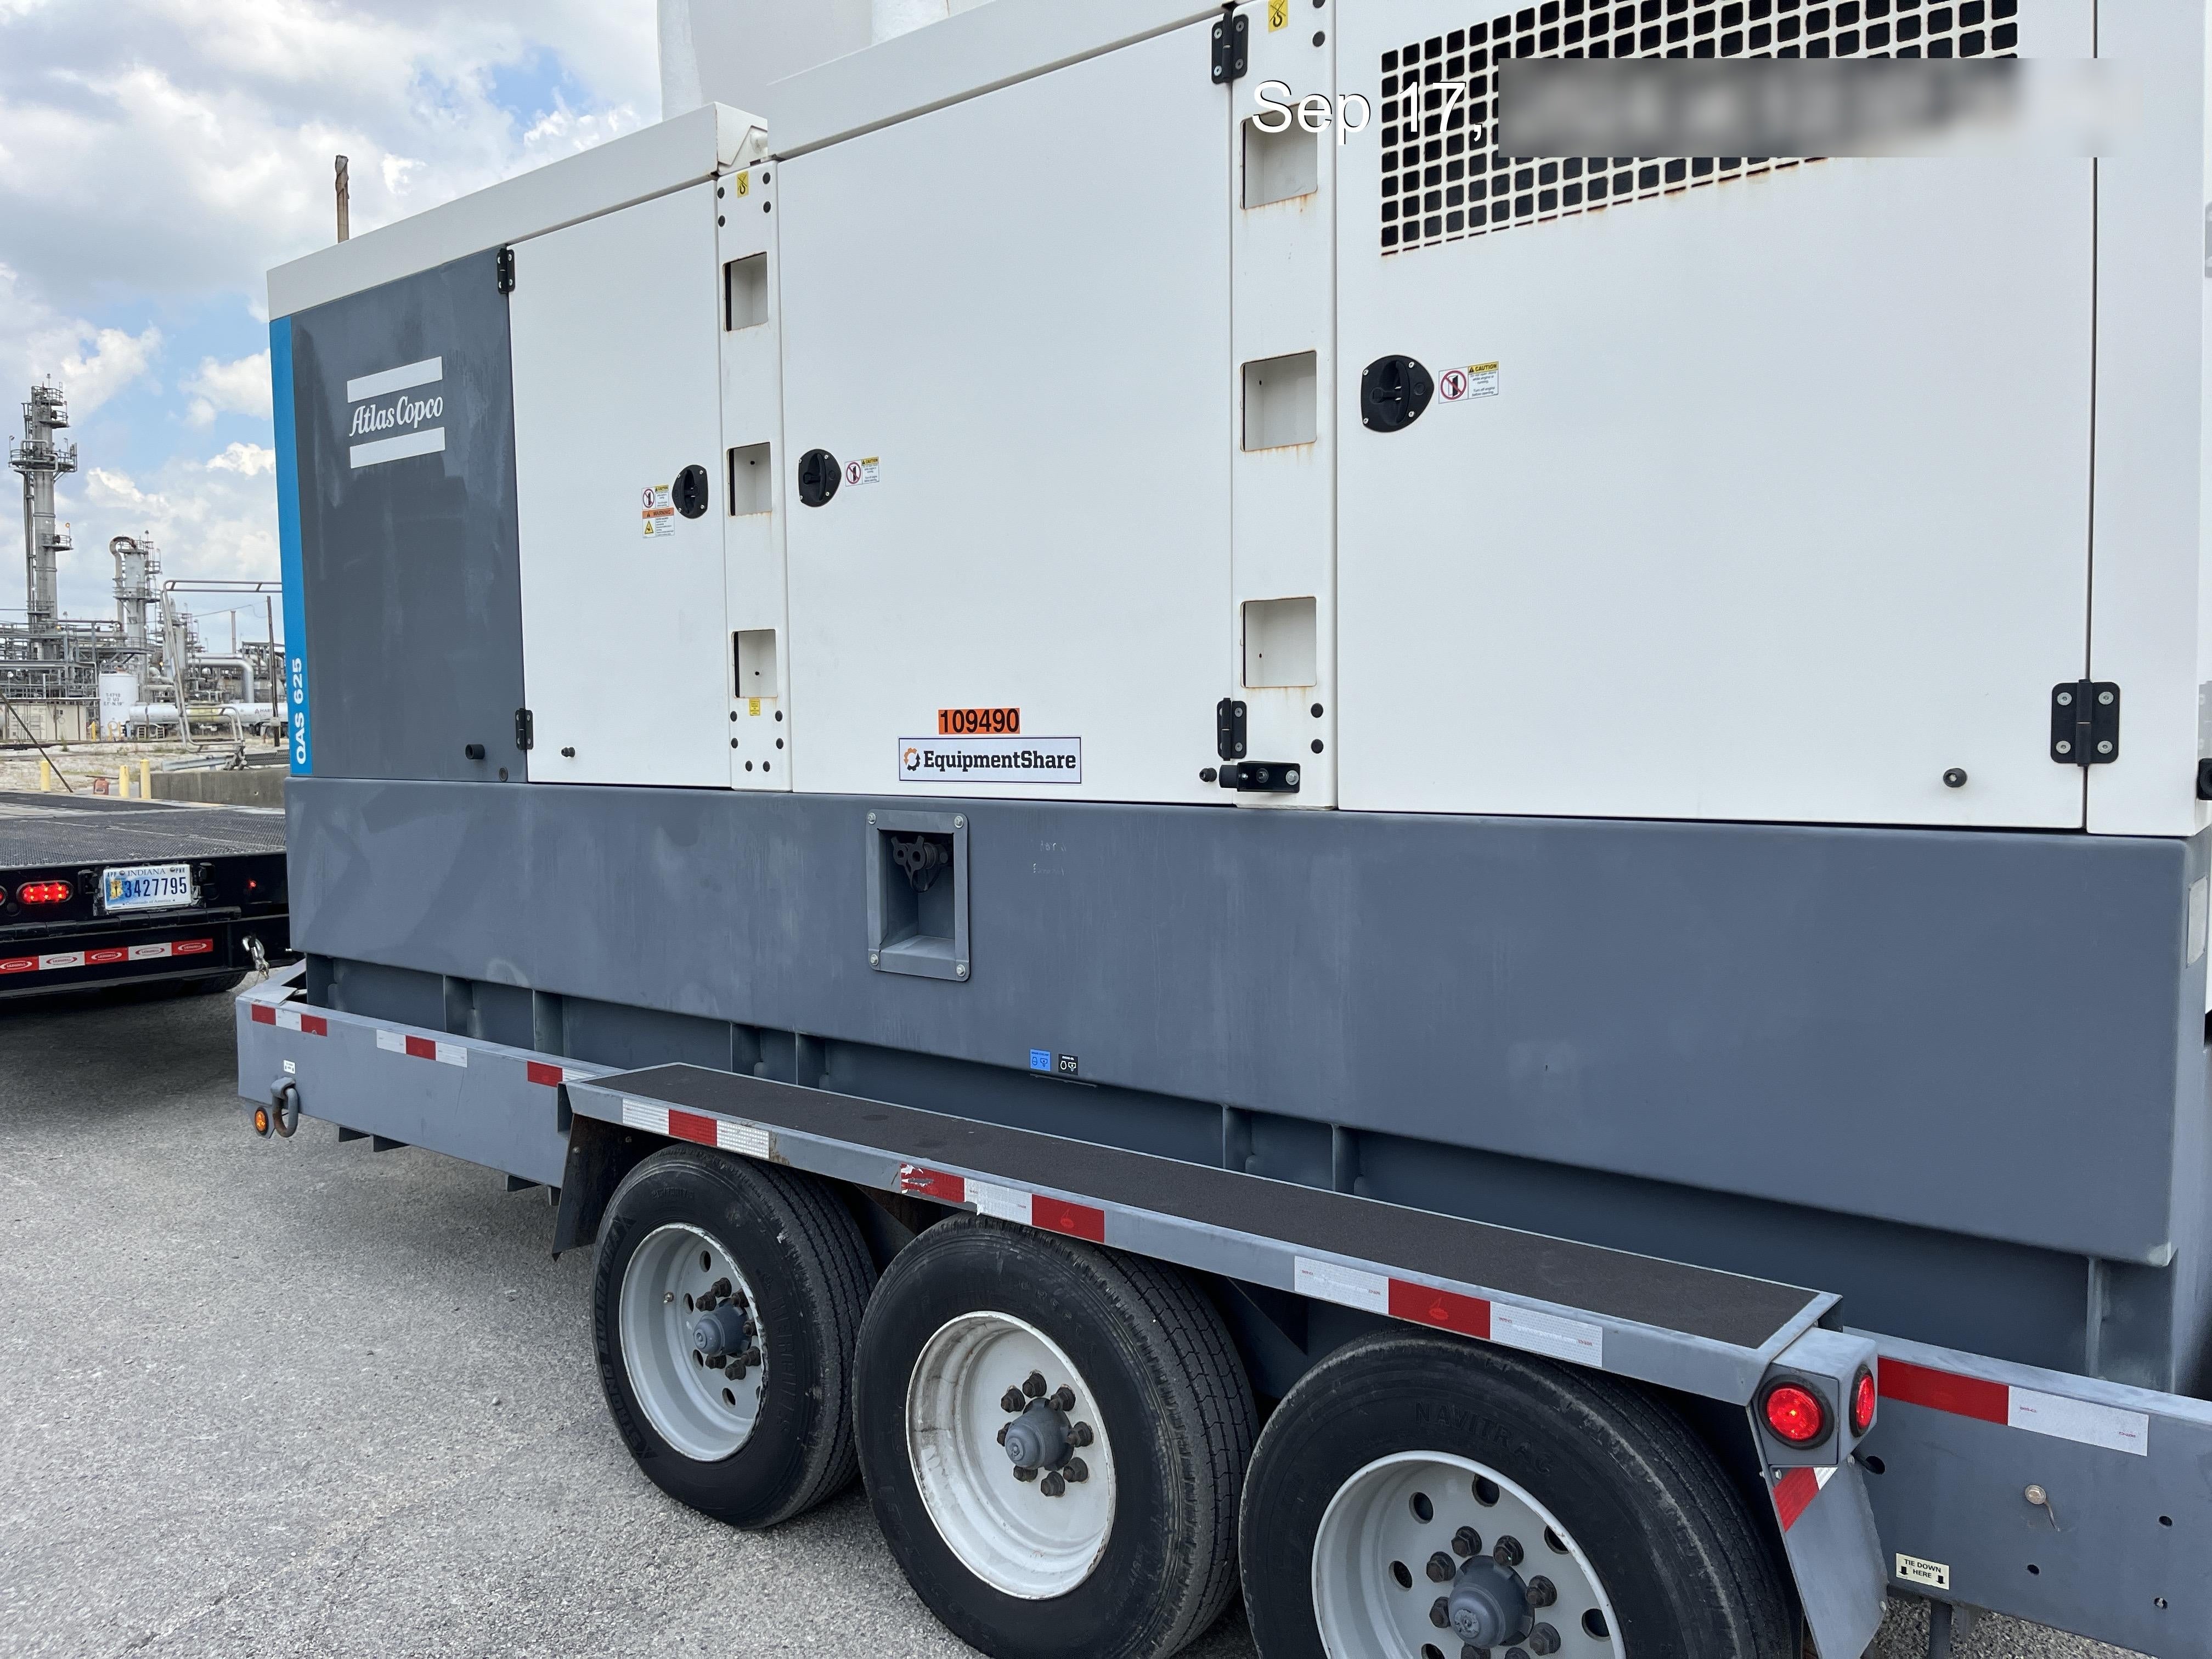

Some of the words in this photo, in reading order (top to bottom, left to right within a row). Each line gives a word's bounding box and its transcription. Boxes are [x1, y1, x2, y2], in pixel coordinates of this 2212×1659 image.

[1475, 363, 1497, 372] CAUTION
[349, 404, 395, 437] Atlas
[396, 396, 443, 428] Copco
[292, 658, 304, 704] 625
[940, 708, 1019, 733] 109490
[295, 712, 307, 765] QAS
[923, 750, 1076, 772] EquipmentShare
[128, 868, 166, 877] INDIANA
[124, 877, 187, 898] 3427795
[1904, 1559, 1915, 1567] TIE
[1917, 1561, 1941, 1573] DOWN
[1912, 1568, 1932, 1578] HERE
